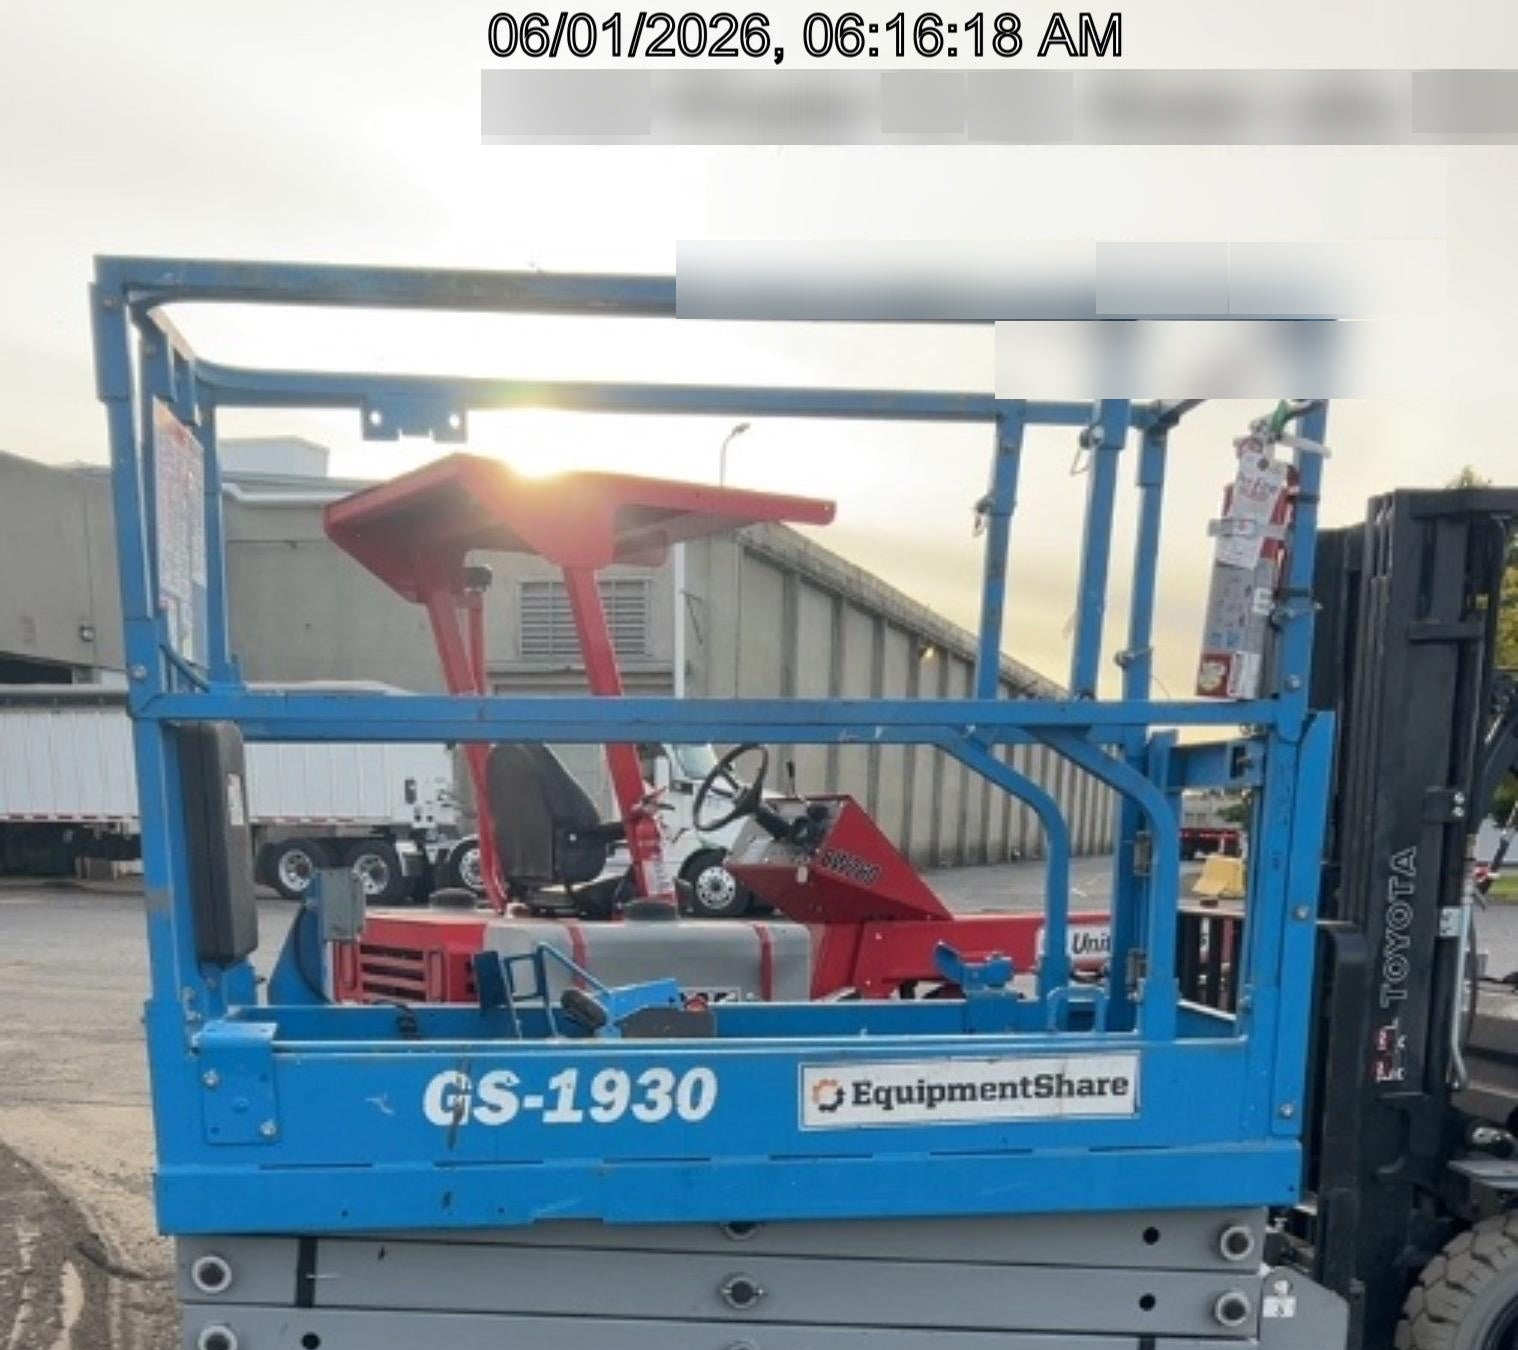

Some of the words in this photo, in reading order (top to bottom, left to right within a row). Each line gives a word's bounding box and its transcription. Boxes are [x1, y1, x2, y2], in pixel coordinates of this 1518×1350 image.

[1380, 846, 1416, 1008] TOYOTA
[423, 1067, 718, 1126] GS-1930
[851, 1073, 1129, 1110] EquipmentShare
